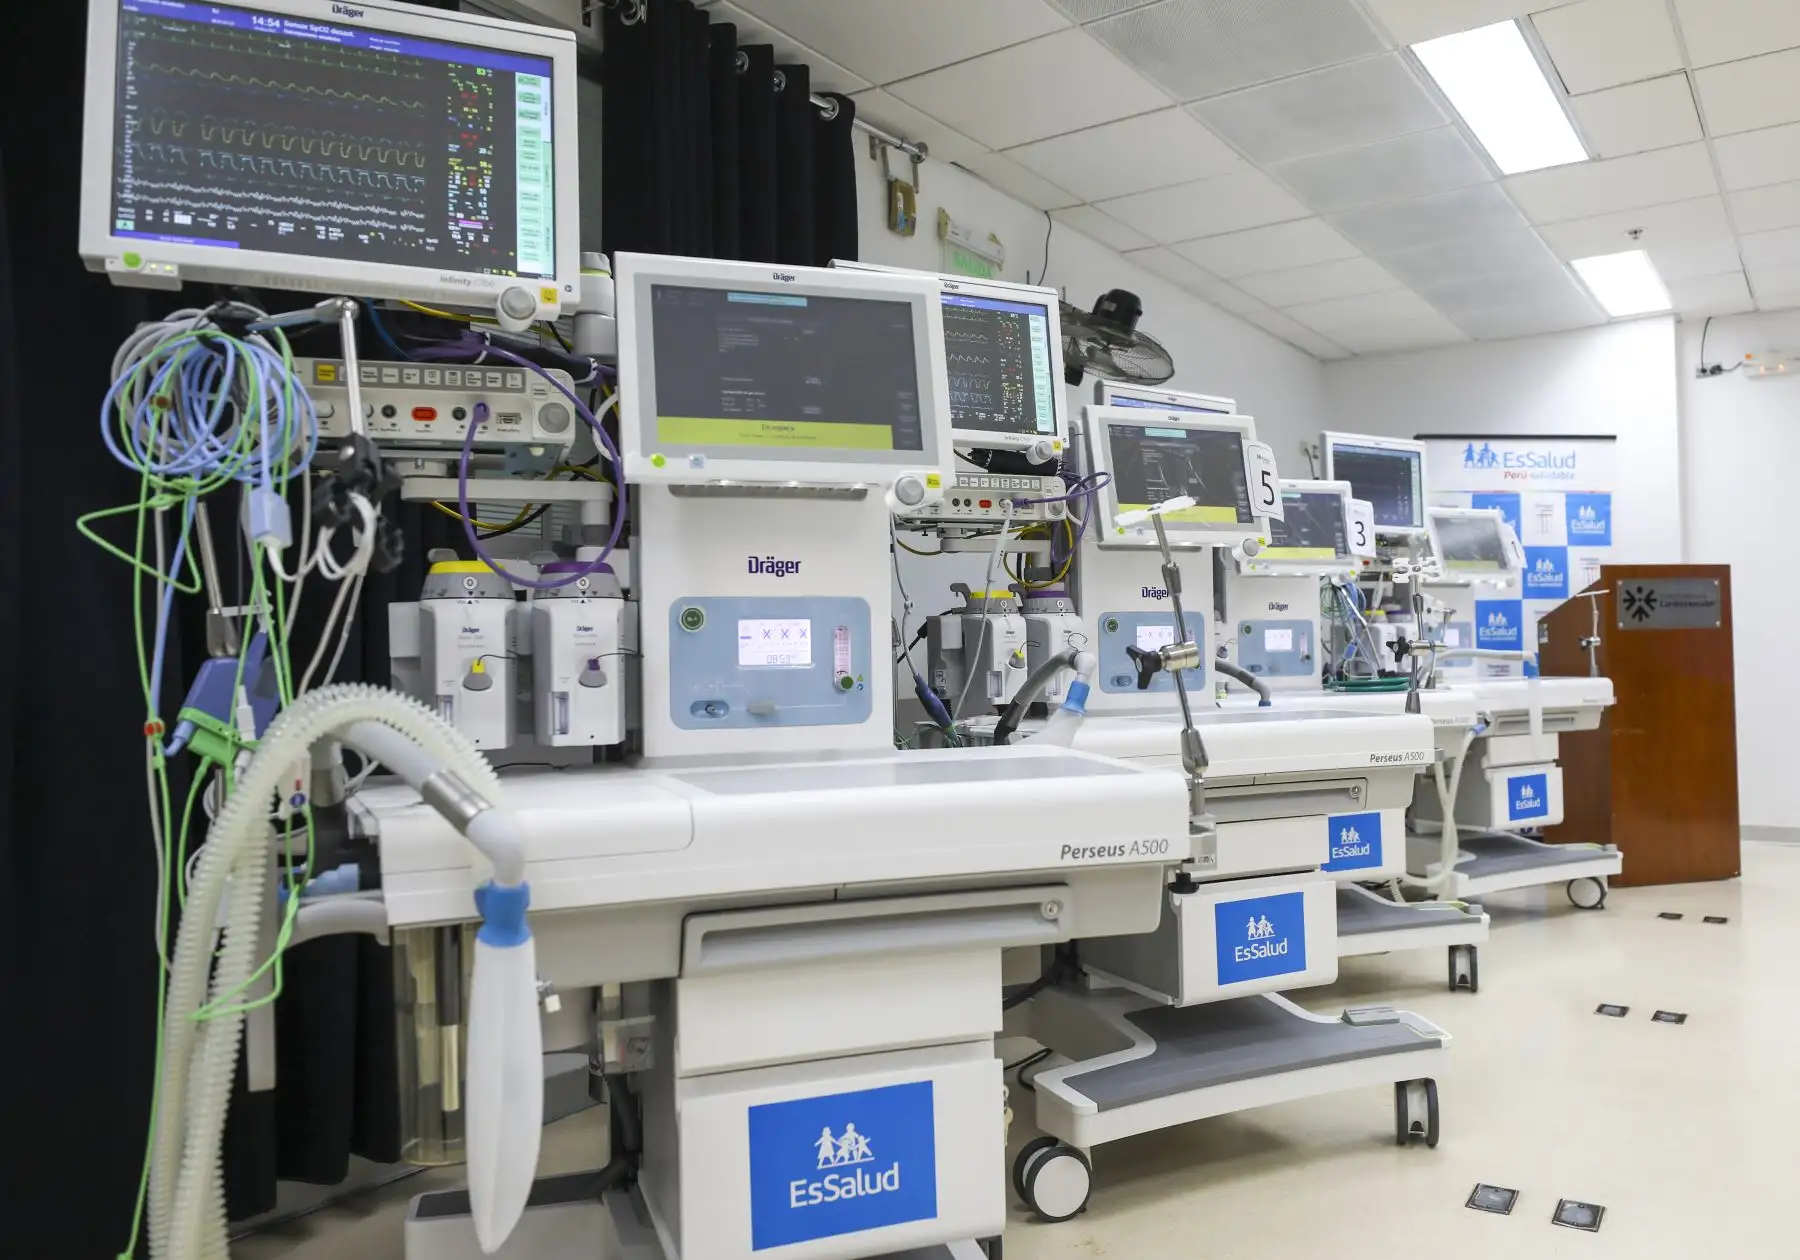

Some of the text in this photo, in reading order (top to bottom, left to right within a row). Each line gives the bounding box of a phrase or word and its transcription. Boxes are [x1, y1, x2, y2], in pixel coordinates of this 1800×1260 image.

[332, 4, 364, 18] Dräger
[252, 15, 280, 28] 14:54
[773, 272, 795, 282] Dräger
[1503, 449, 1576, 469] EsSalud
[1503, 470, 1528, 480] Perú
[1262, 470, 1274, 506] 5
[1355, 521, 1366, 546] 3
[748, 556, 802, 578] Dräger
[1527, 571, 1563, 583] EsSalud
[1269, 601, 1289, 611] Dräger
[1370, 751, 1425, 763] Perseus A500
[1515, 797, 1541, 810] EsSalud
[1060, 838, 1169, 861] Perseus A500
[1332, 843, 1370, 859] EsSalud
[1234, 937, 1289, 963] EsSalud
[789, 1161, 900, 1209] EsSalud
